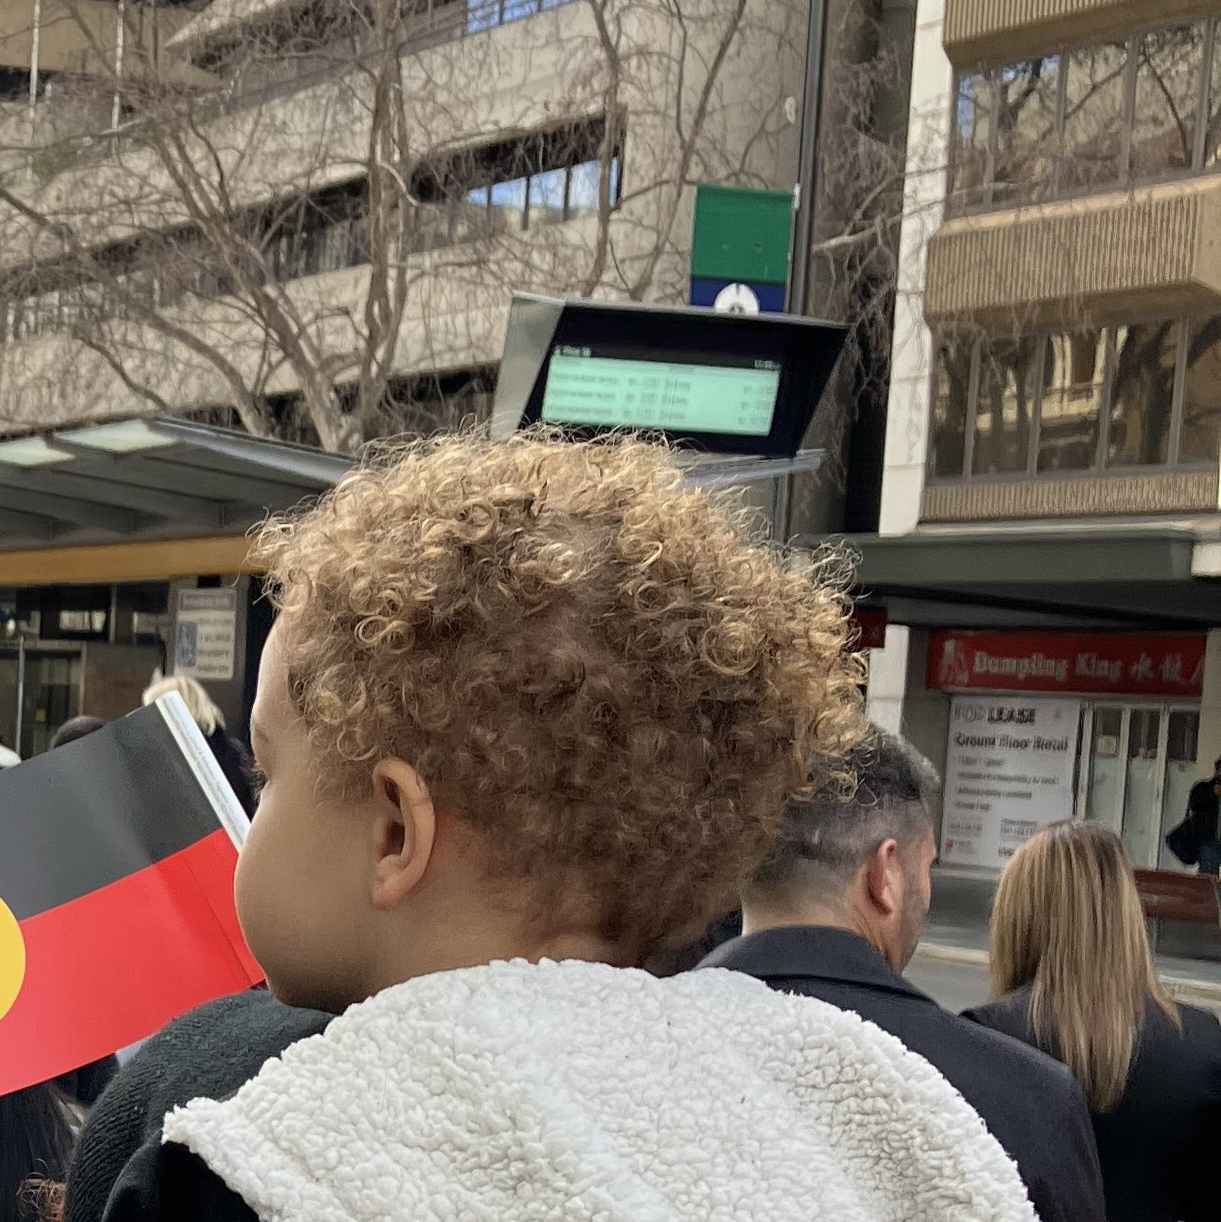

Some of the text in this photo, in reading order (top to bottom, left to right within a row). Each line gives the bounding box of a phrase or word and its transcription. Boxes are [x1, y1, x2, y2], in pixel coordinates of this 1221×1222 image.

[973, 650, 1122, 683] Dumpling King
[986, 706, 1036, 725] LEASE
[953, 731, 996, 748] Ground
